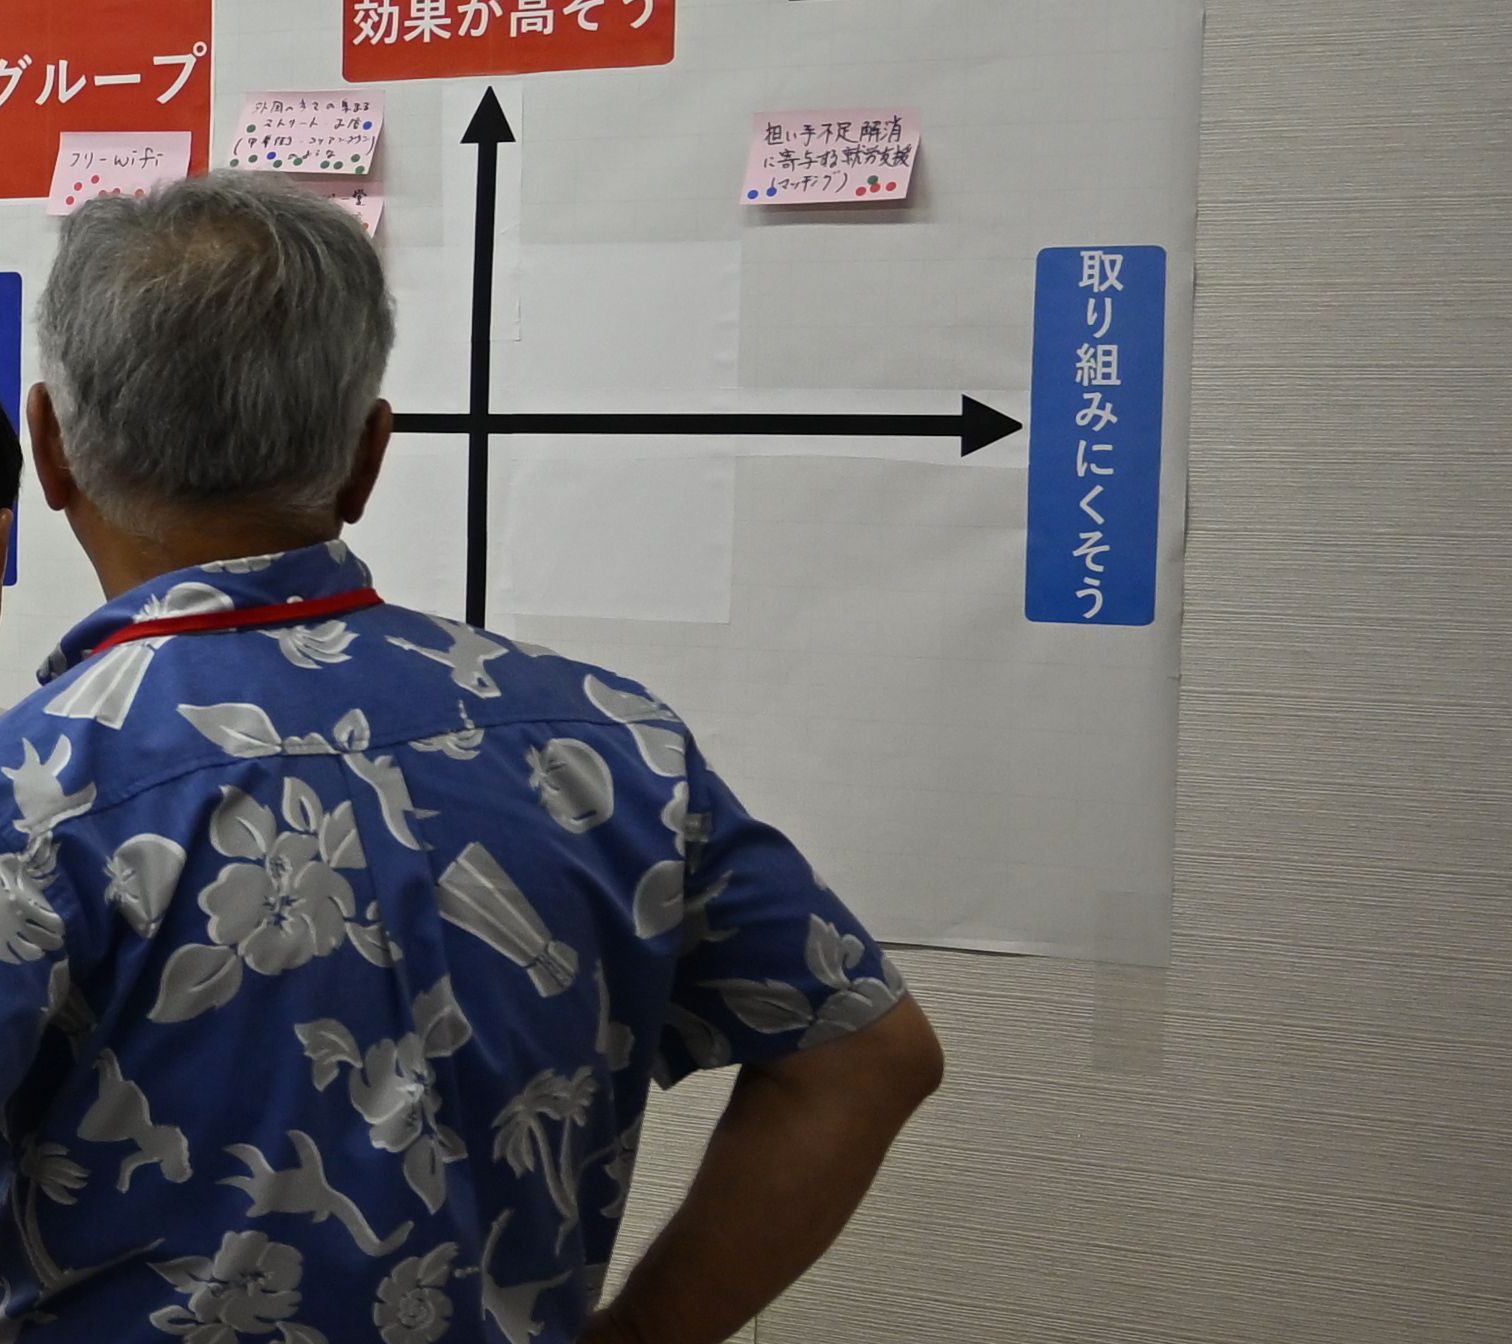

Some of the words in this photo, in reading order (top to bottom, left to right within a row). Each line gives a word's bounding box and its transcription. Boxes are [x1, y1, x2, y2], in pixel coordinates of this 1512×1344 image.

[765, 115, 904, 146] 担い手不足解消
[763, 144, 913, 172] に寄与する就労支援
[1072, 250, 1125, 619] 取り組みにくそう
